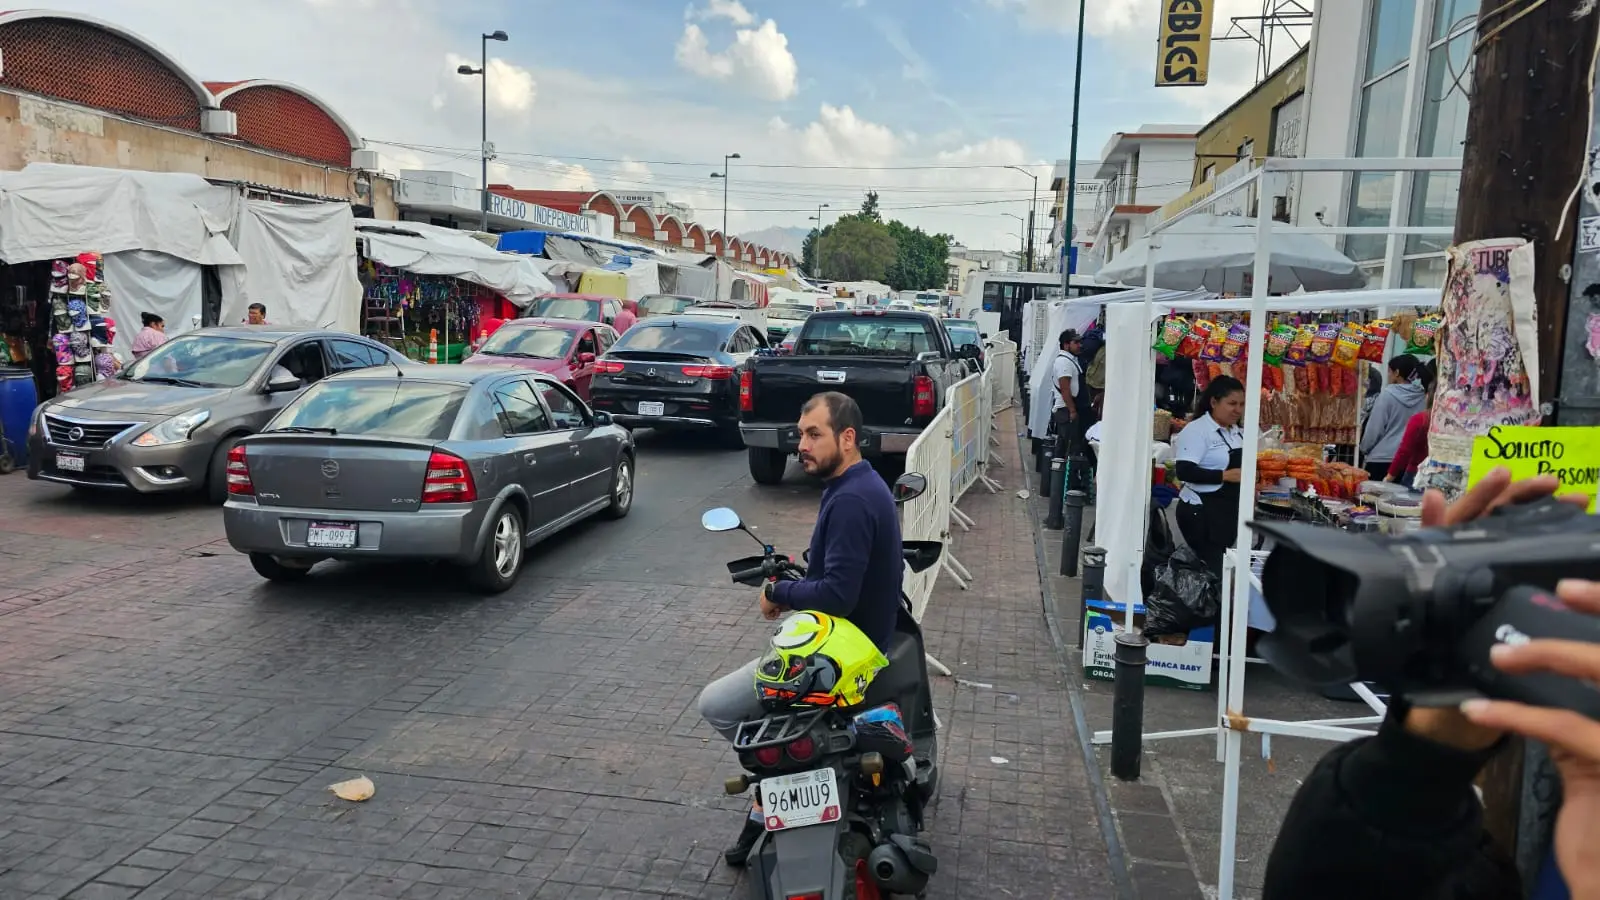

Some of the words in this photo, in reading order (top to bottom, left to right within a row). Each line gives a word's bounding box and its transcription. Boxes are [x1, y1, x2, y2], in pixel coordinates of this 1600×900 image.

[490, 194, 526, 220] ERCADO
[534, 205, 591, 234] INDEPENDENCIA
[1537, 461, 1600, 485] PRSON
[309, 529, 355, 541] PMT-099-E
[1180, 664, 1202, 672] BABY
[768, 783, 830, 813] 96MUU9
